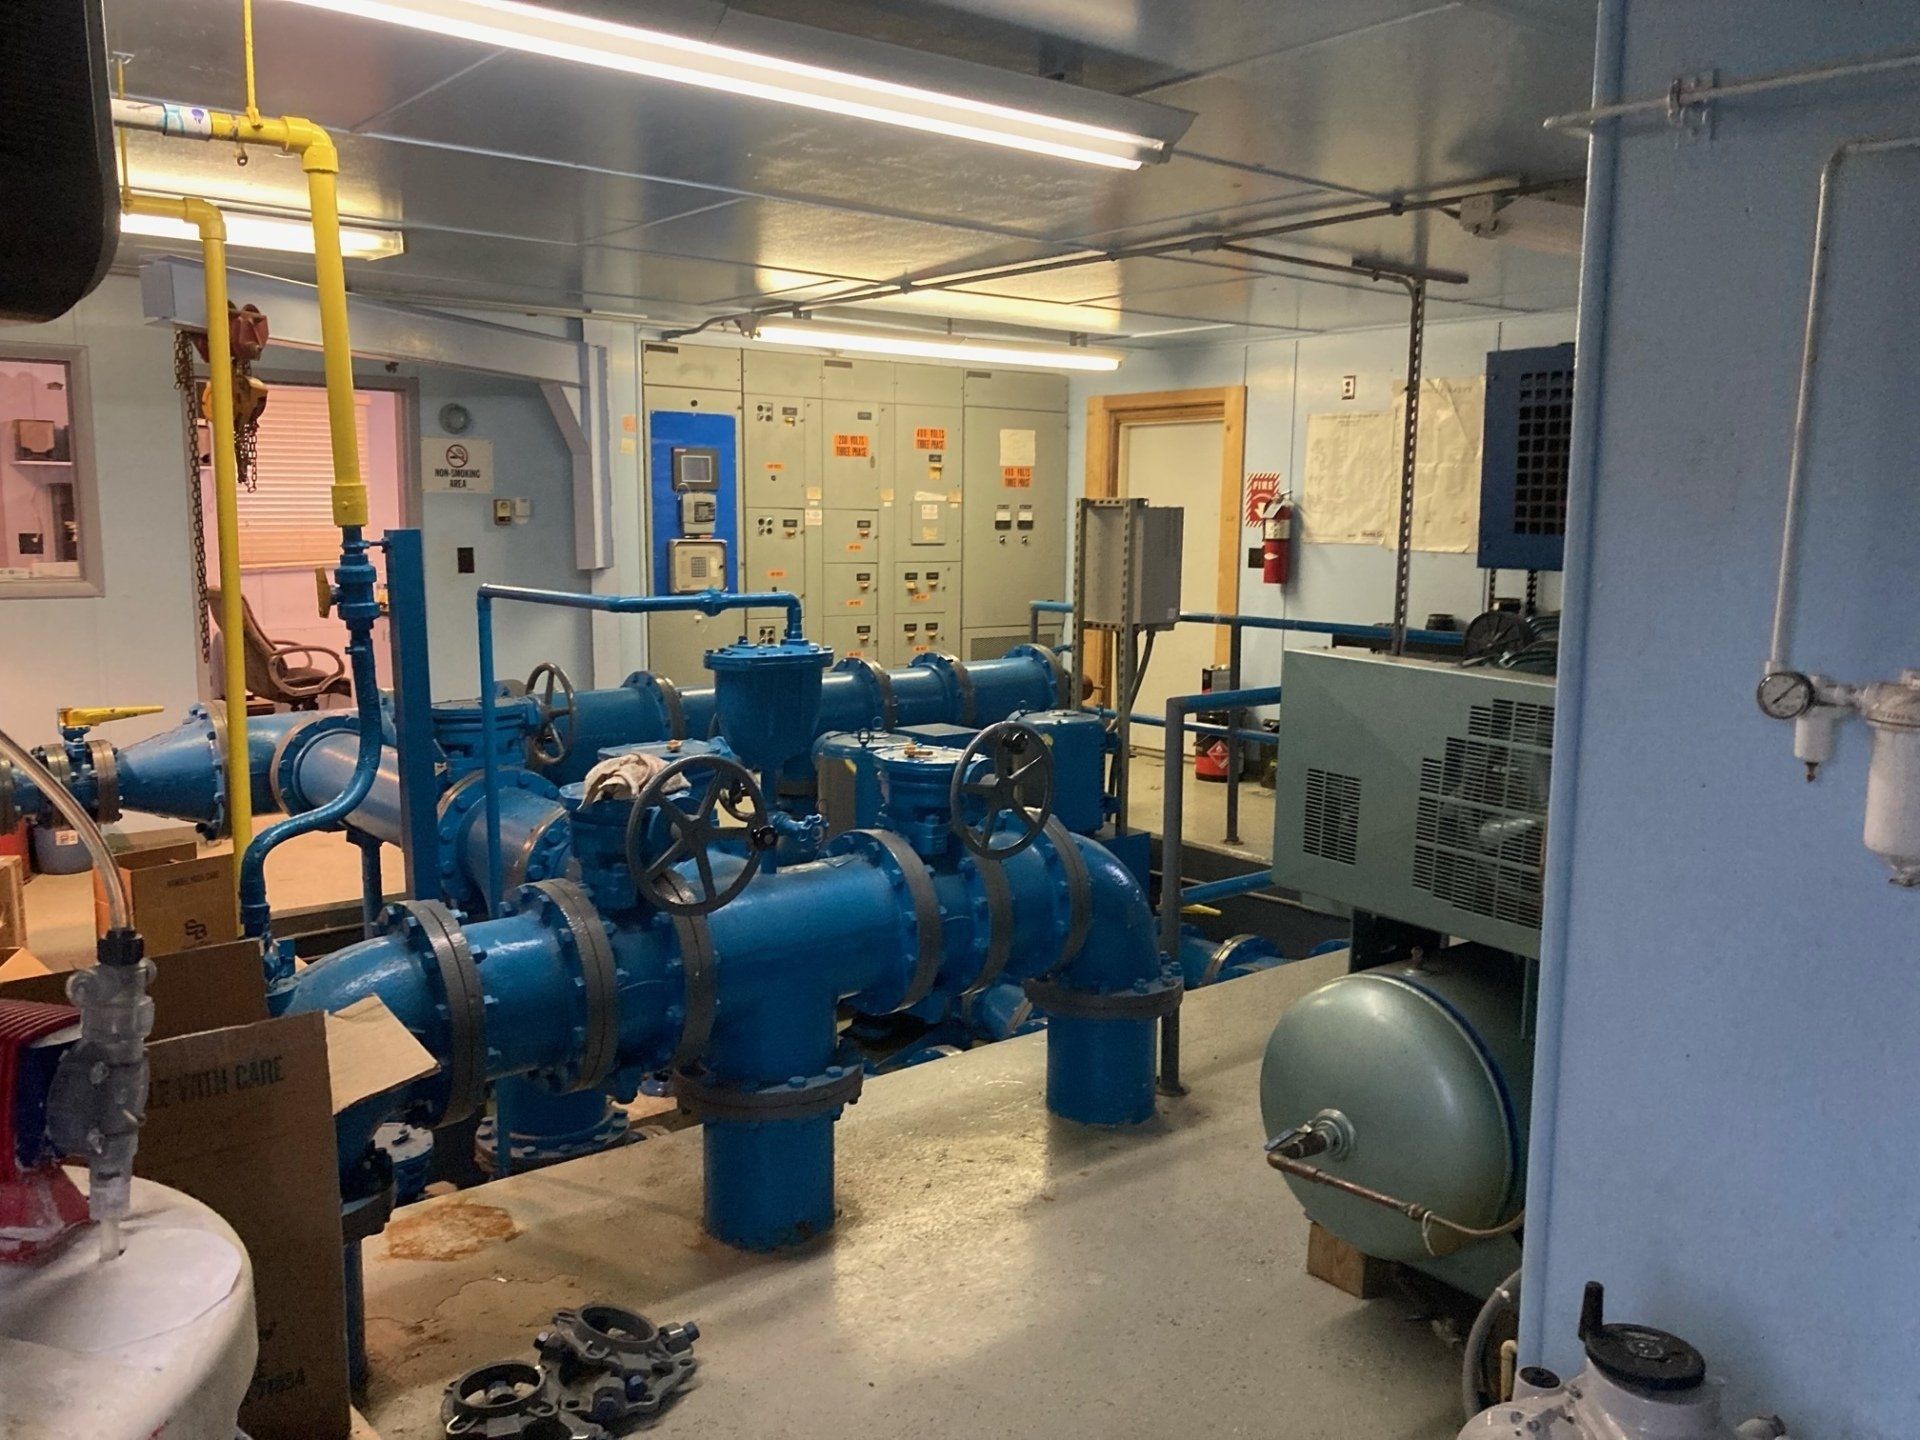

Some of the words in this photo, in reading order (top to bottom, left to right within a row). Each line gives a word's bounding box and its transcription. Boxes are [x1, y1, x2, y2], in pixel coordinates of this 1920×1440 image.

[434, 468, 480, 478] NON-SMOKING
[449, 479, 467, 489] AREA
[1252, 480, 1274, 490] FIRE
[235, 1055, 284, 1091] CARE
